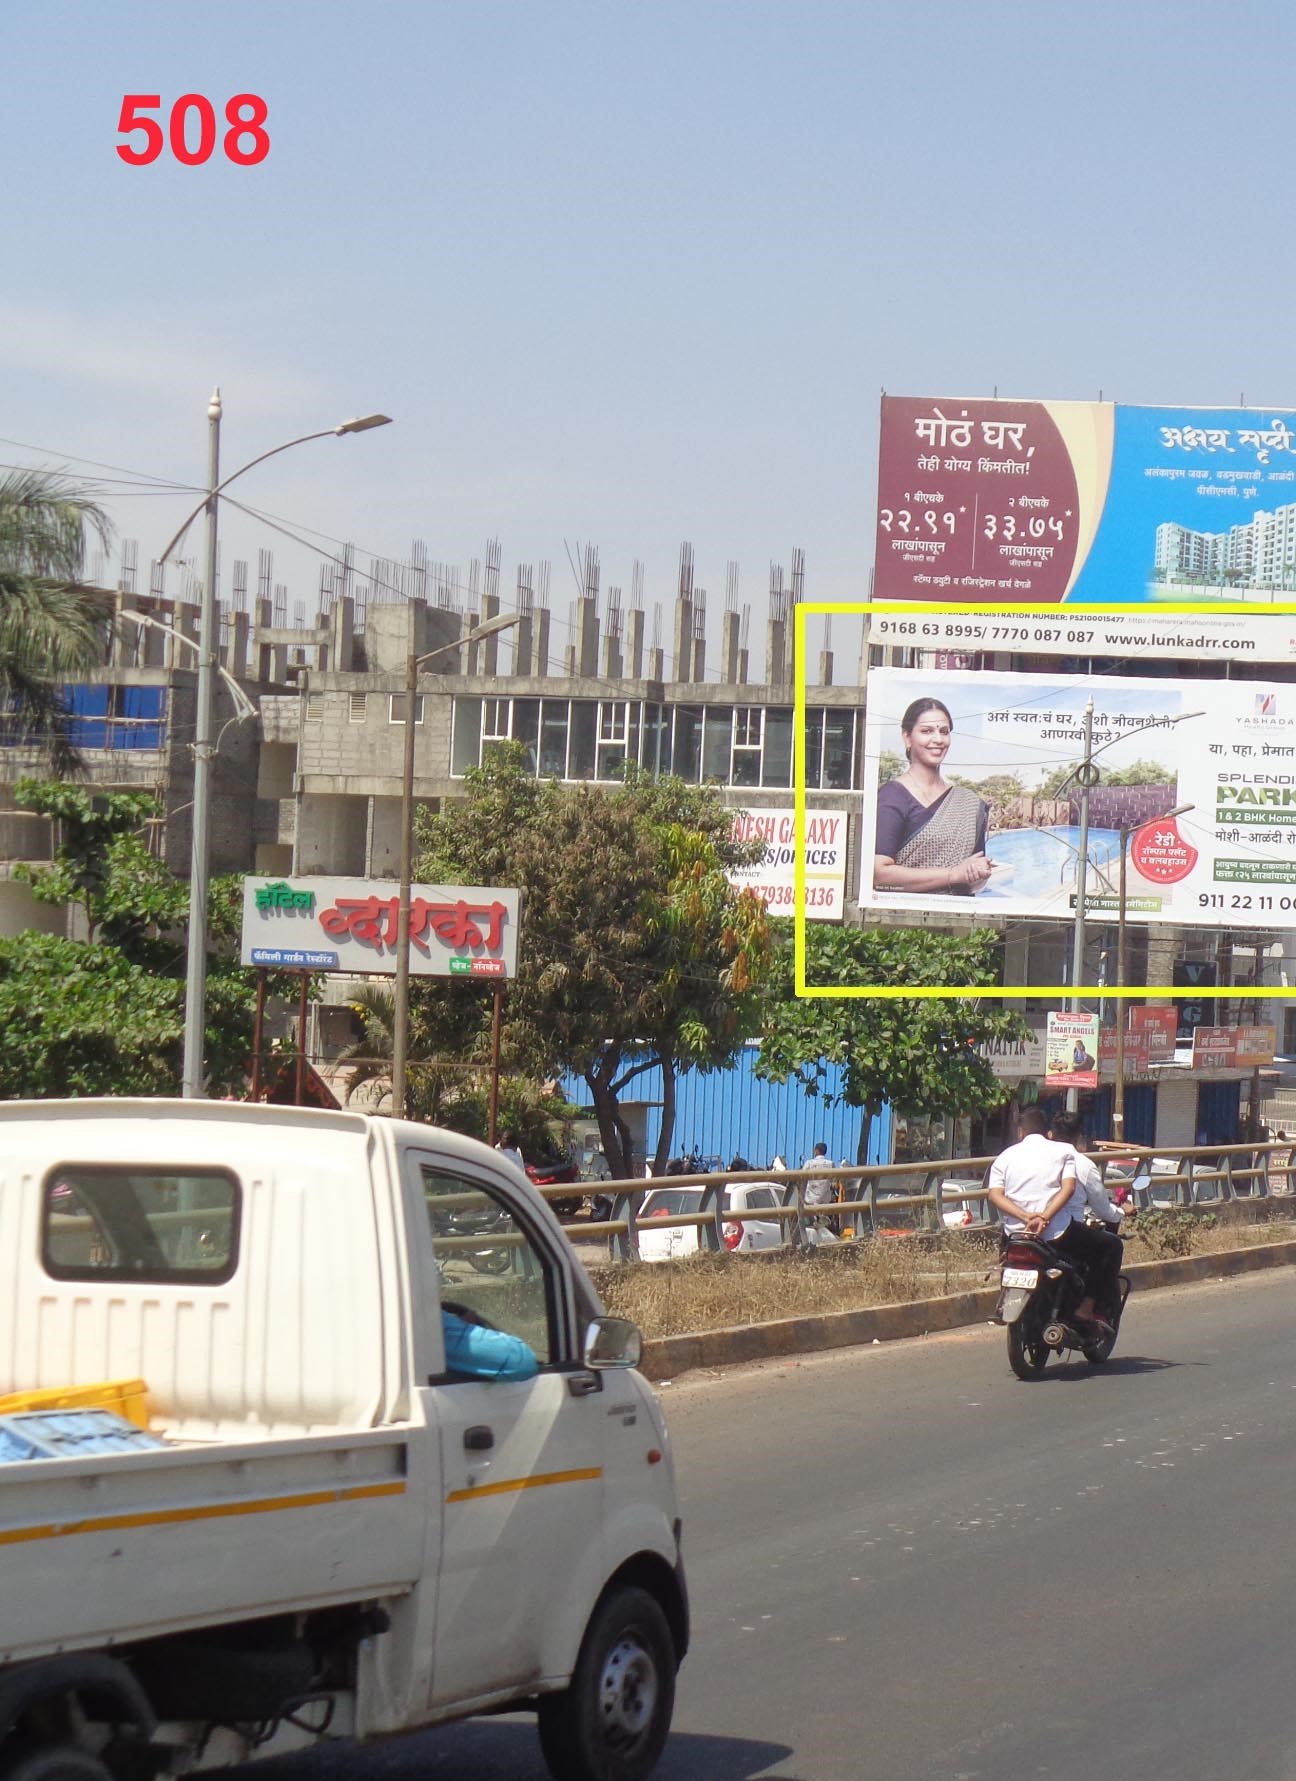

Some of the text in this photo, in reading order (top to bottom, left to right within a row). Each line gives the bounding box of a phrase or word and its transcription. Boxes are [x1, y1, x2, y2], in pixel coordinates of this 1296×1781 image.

[914, 407, 1035, 458] मोठं घर,
[1159, 425, 1236, 453] अक्षय
[918, 454, 1030, 475] तेही योग्य किंमतीत!
[892, 537, 946, 555] लाखांपासून
[999, 542, 1054, 561] लाखांपासून
[880, 620, 1256, 650] 9168 63 8995/ 7770 087 087 www.lunkadrr.com
[987, 709, 1010, 723] असं
[1056, 712, 1076, 727] घर,
[1236, 717, 1294, 725] YASHADA
[1208, 743, 1228, 757] या,
[1232, 744, 1257, 758] पहा,
[1261, 743, 1293, 758] प्रेमात
[1225, 812, 1233, 821] &
[1235, 812, 1242, 822] 2
[1243, 813, 1267, 823] BHK
[1154, 831, 1175, 847] रेडी
[255, 880, 315, 911] हॉटेल
[1199, 893, 1224, 908] 911
[1231, 895, 1252, 909] 22
[1258, 896, 1273, 910] 11
